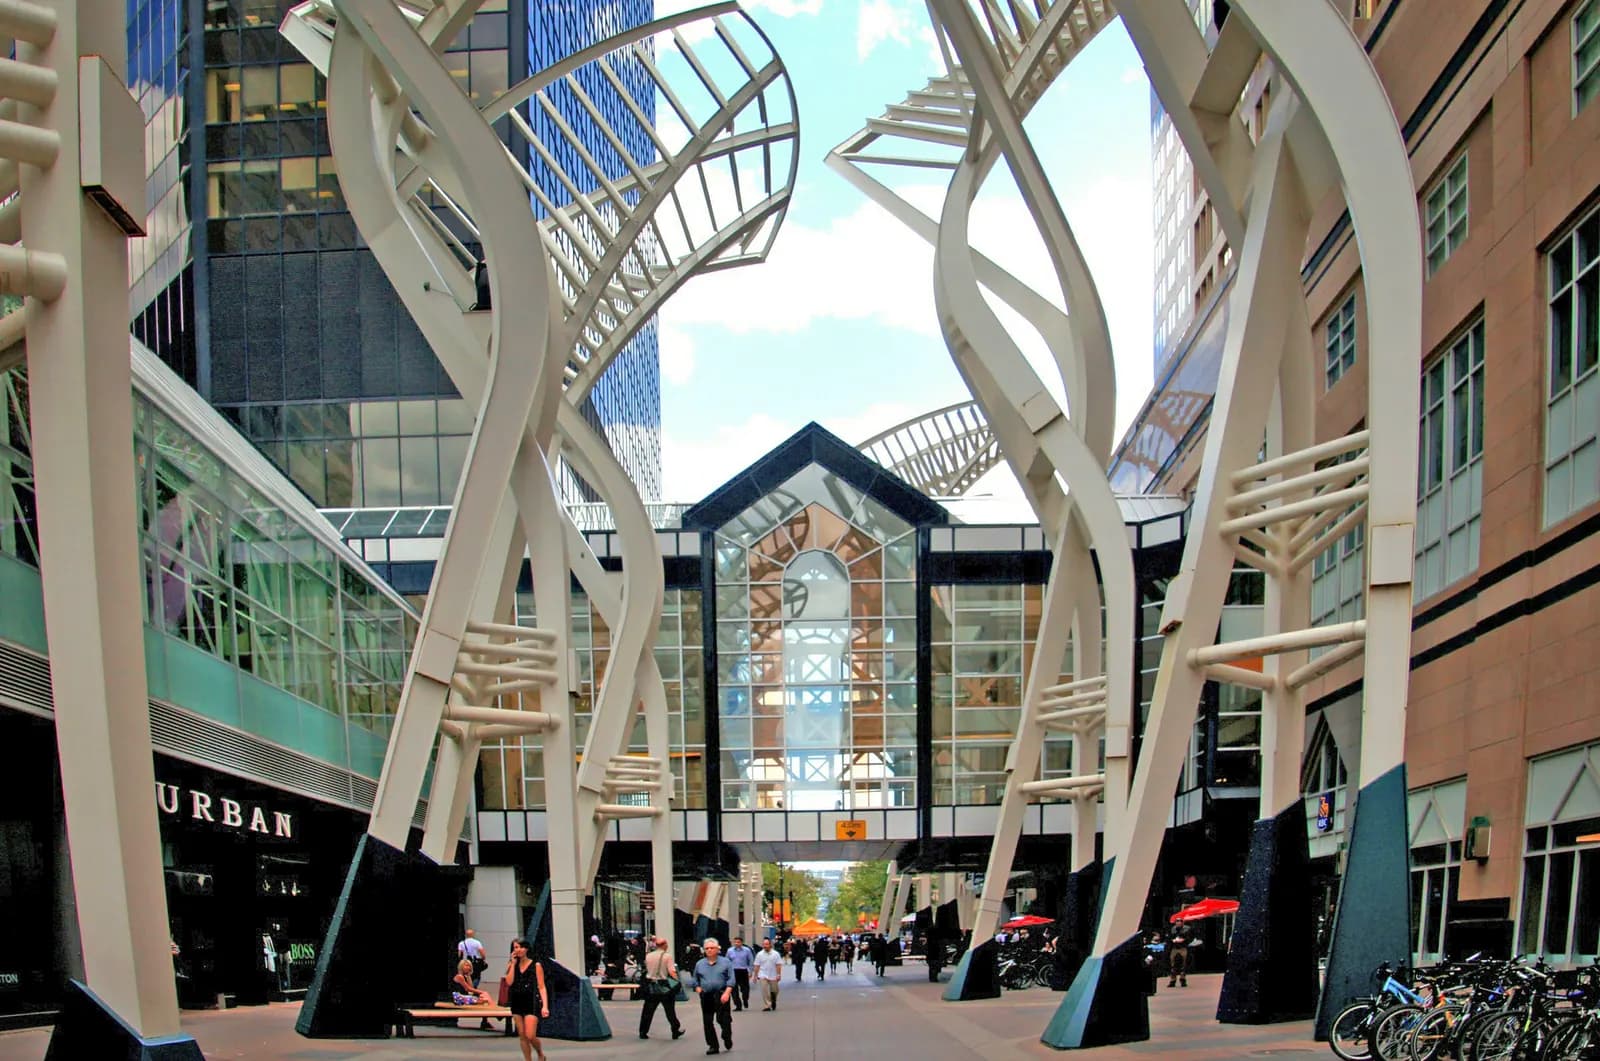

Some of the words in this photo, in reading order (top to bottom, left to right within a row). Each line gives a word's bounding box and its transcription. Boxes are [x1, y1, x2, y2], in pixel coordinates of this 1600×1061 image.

[155, 781, 293, 838] URBAN
[290, 943, 316, 960] BOSS
[0, 973, 19, 984] TON
